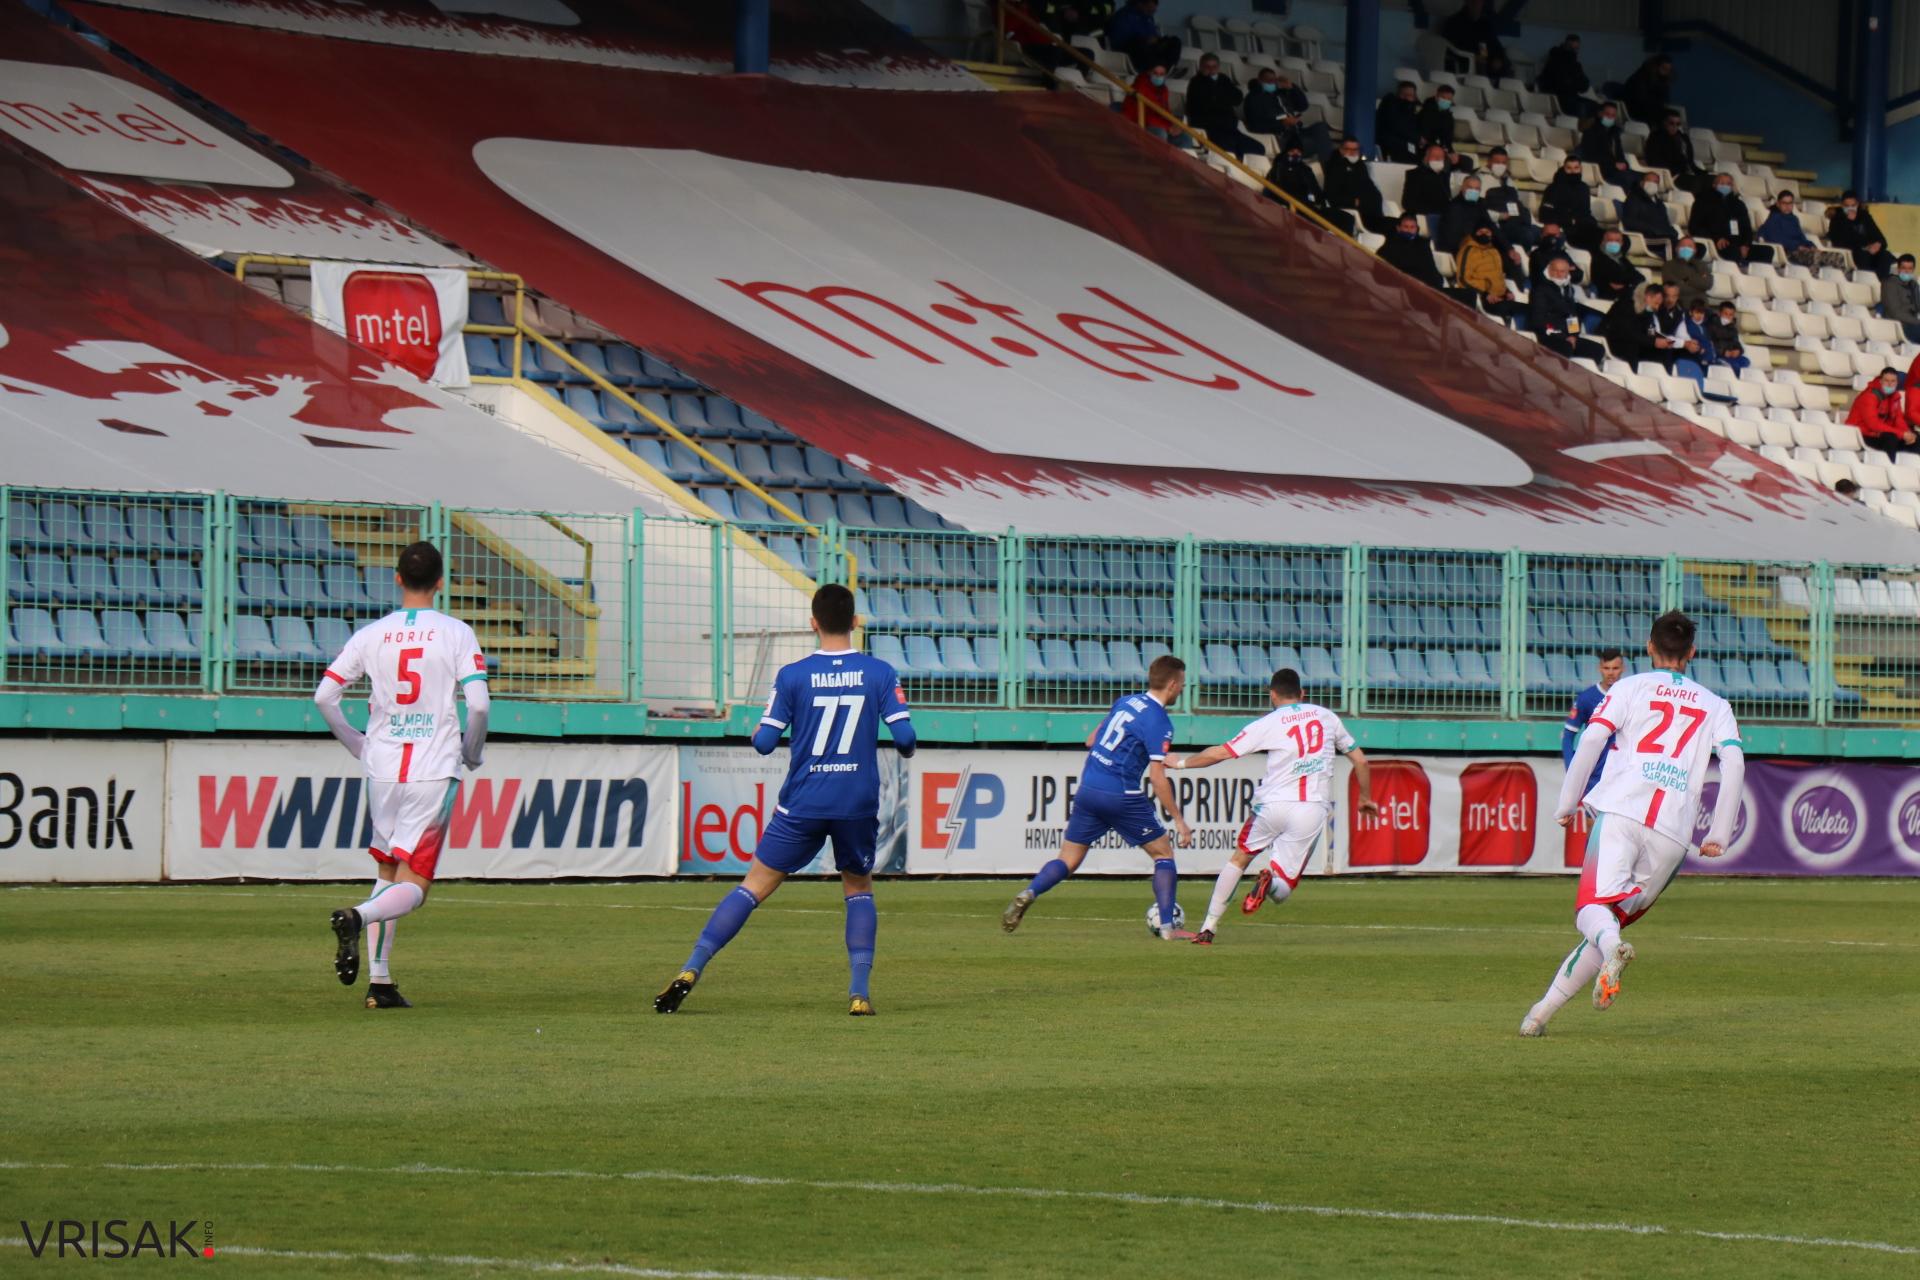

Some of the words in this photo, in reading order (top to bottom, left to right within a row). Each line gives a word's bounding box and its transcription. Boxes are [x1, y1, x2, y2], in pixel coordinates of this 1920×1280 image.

[0, 100, 217, 147] m:tel
[355, 304, 431, 346] m:tel
[714, 277, 1316, 397] m:tel
[383, 629, 435, 643] HORIĆ
[396, 648, 424, 705] 5
[1656, 684, 1699, 703] GAVRIĆ
[390, 713, 434, 726] OLMPIK
[811, 695, 865, 757] 77
[1099, 710, 1135, 751] 15
[1286, 719, 1324, 758] 10
[1636, 700, 1708, 759] 27
[0, 772, 136, 850] Bank
[920, 772, 1006, 850] EP
[1027, 775, 1057, 822] JP
[1469, 792, 1527, 832] m:tel
[1798, 801, 1849, 834] Violeta
[680, 781, 765, 863] led
[1025, 829, 1063, 849] HRVAT
[1200, 829, 1236, 849] BOSNE
